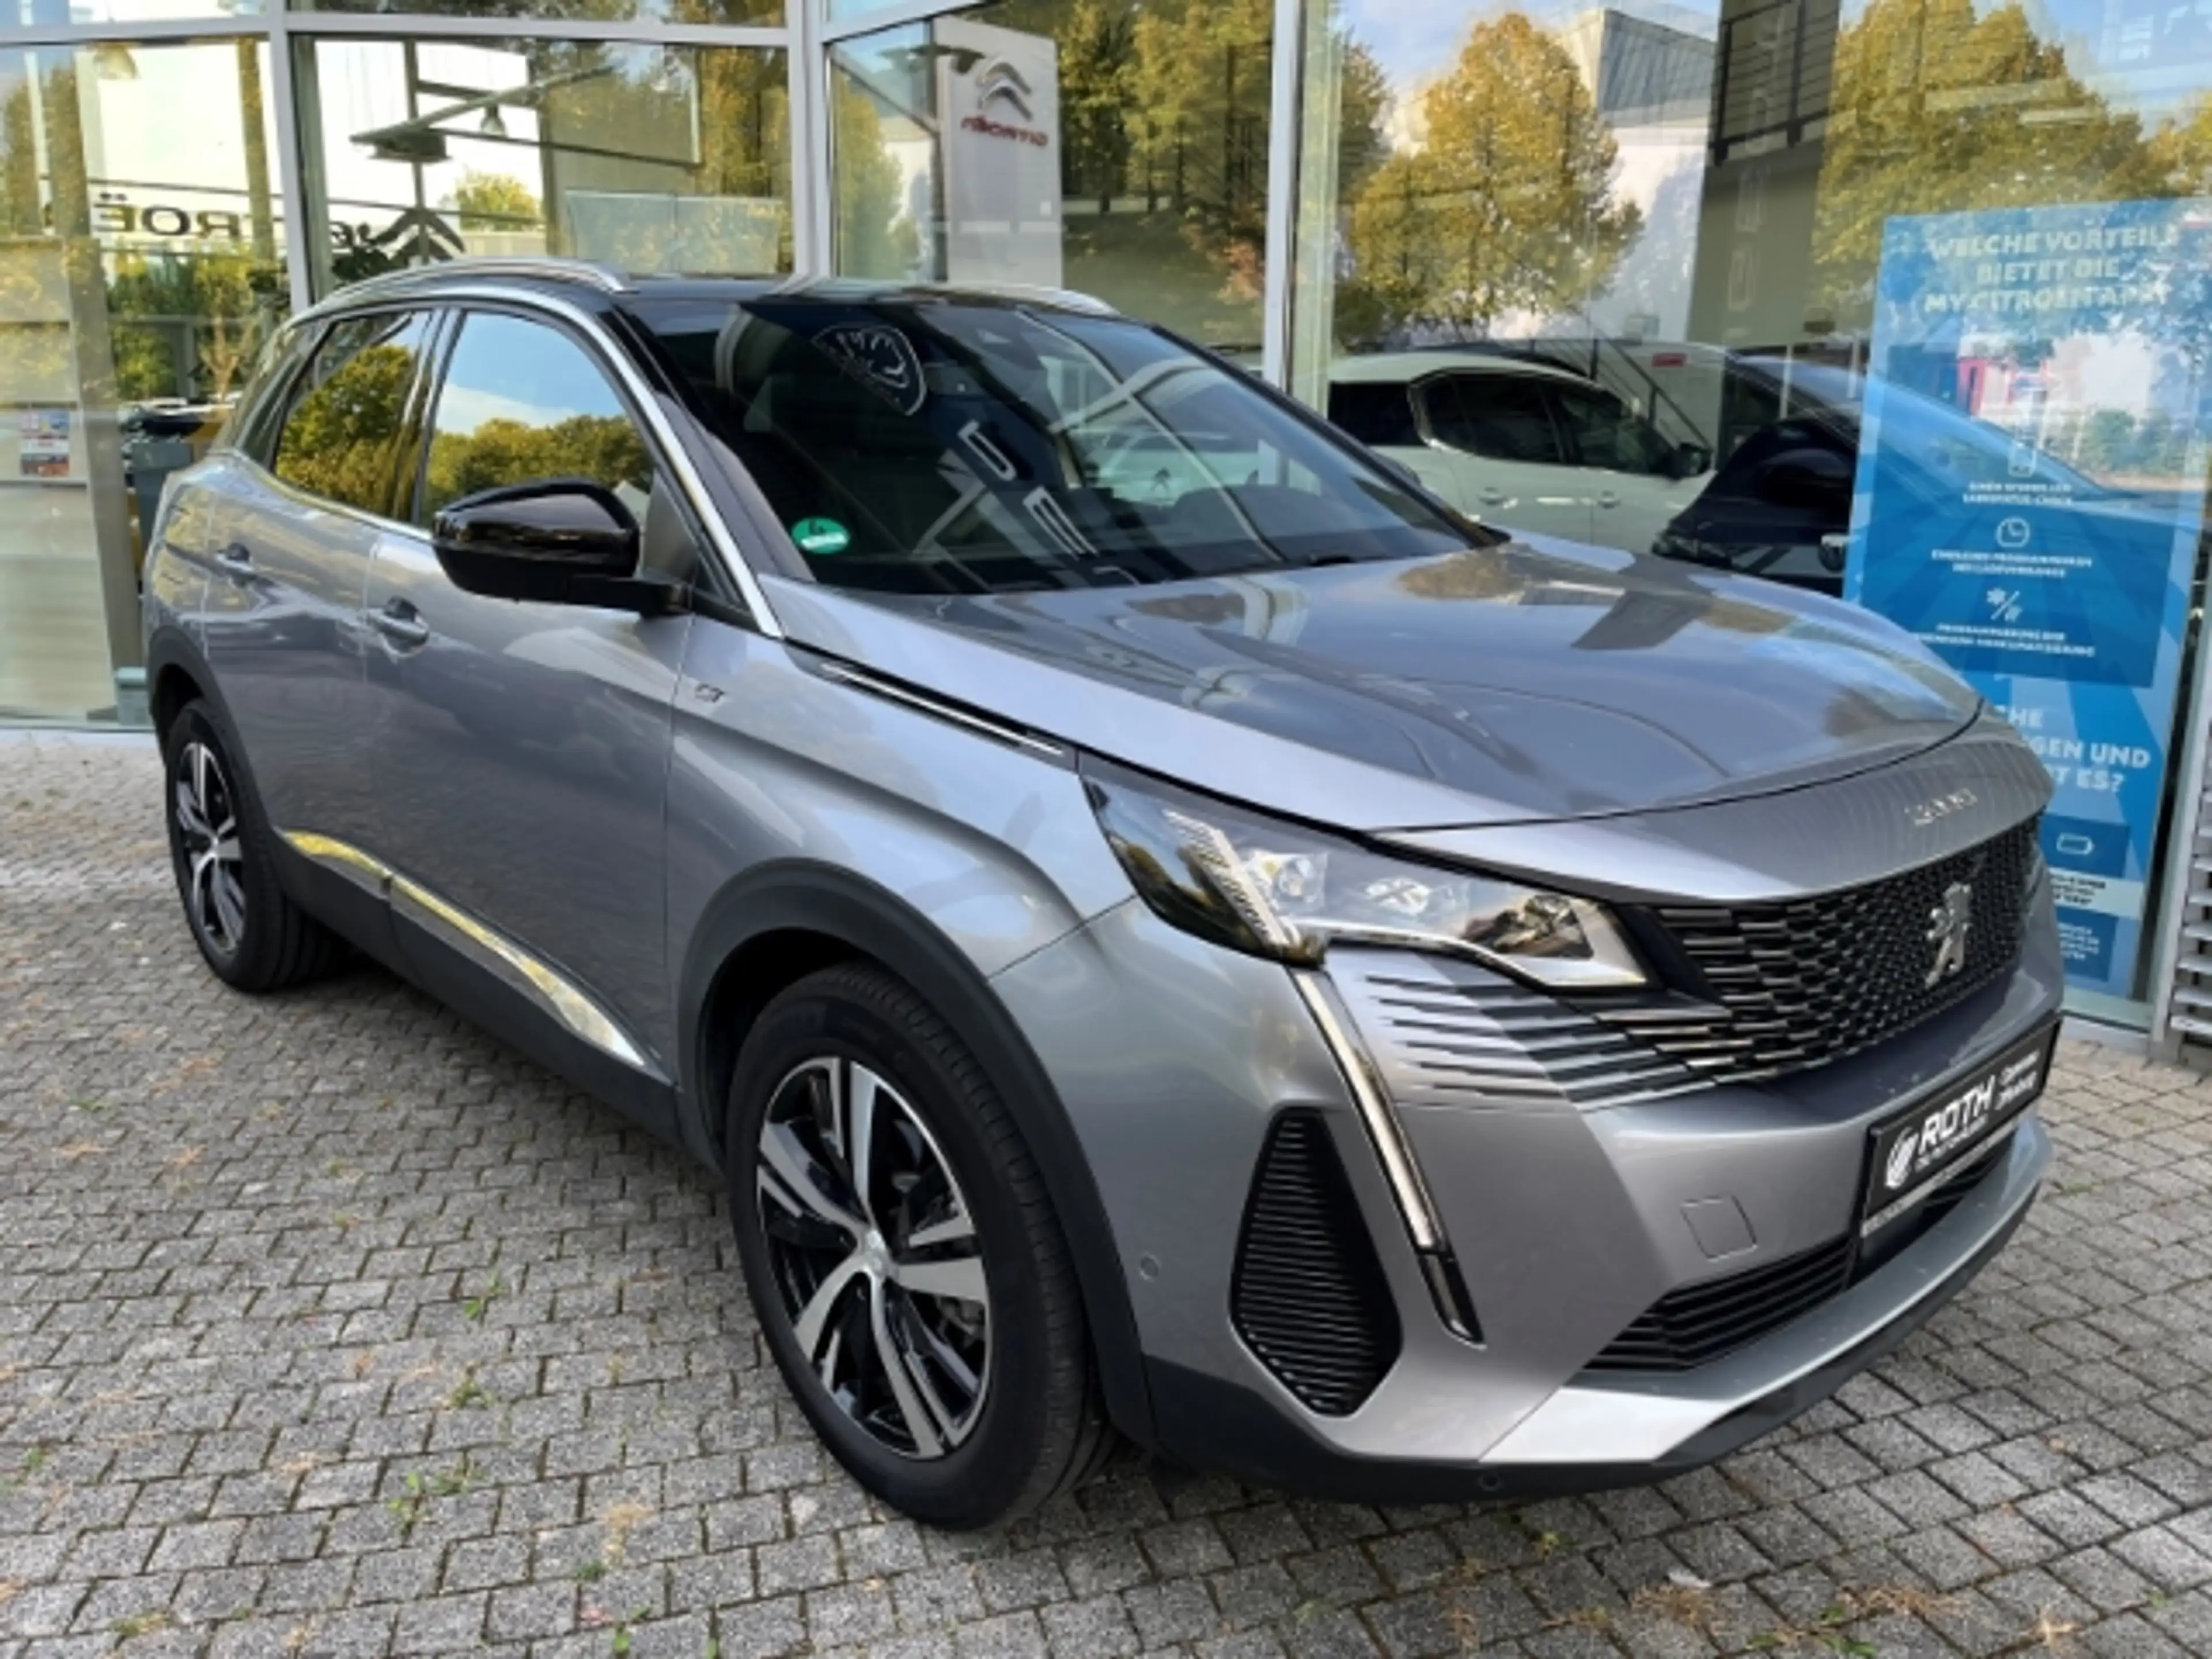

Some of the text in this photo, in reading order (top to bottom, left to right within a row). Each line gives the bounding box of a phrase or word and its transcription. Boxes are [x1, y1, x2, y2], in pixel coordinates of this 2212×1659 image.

[1925, 232, 2039, 257] WELCHE
[1976, 257, 2120, 285] BIETET DIE
[2090, 742, 2151, 768] UND
[2076, 768, 2125, 793] ES?
[1918, 1075, 1995, 1155] ROTH
